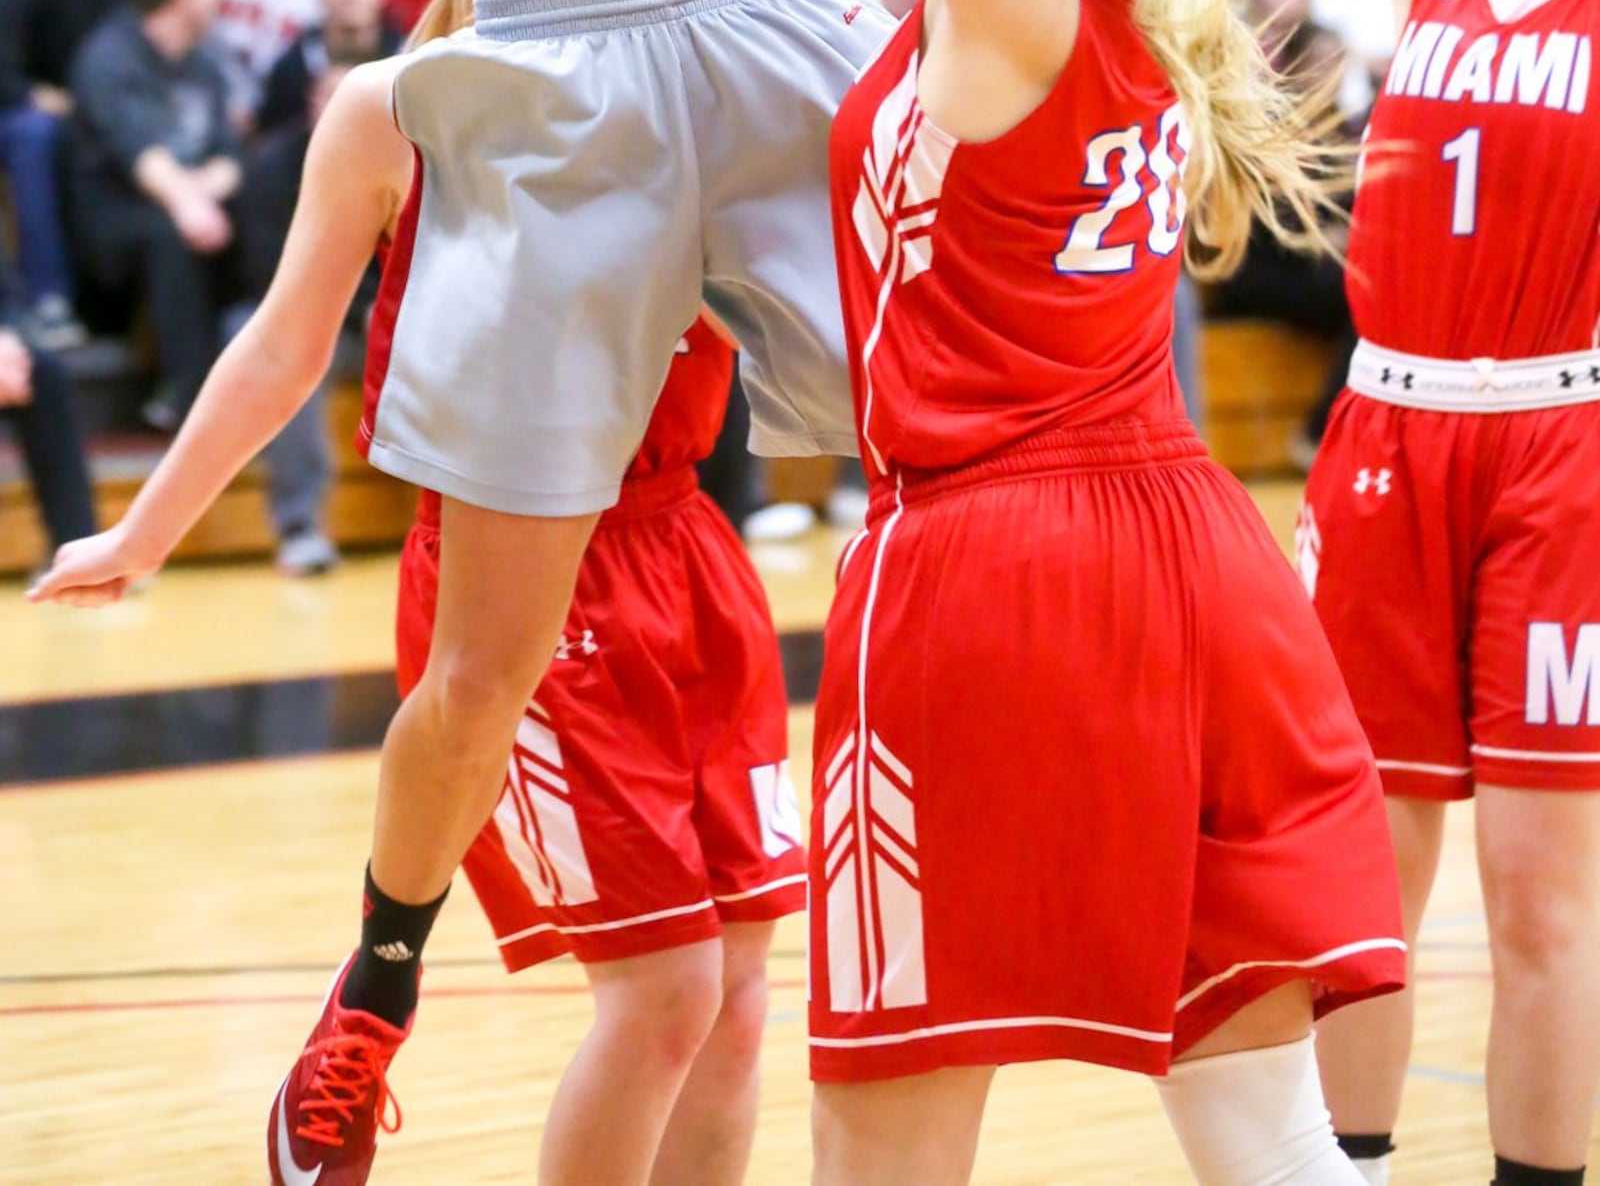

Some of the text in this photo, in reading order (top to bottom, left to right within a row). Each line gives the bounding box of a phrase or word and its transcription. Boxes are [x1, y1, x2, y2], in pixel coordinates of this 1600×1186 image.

[1385, 19, 1591, 114] MIAMI
[1053, 100, 1192, 276] 20
[1440, 126, 1481, 236] 1
